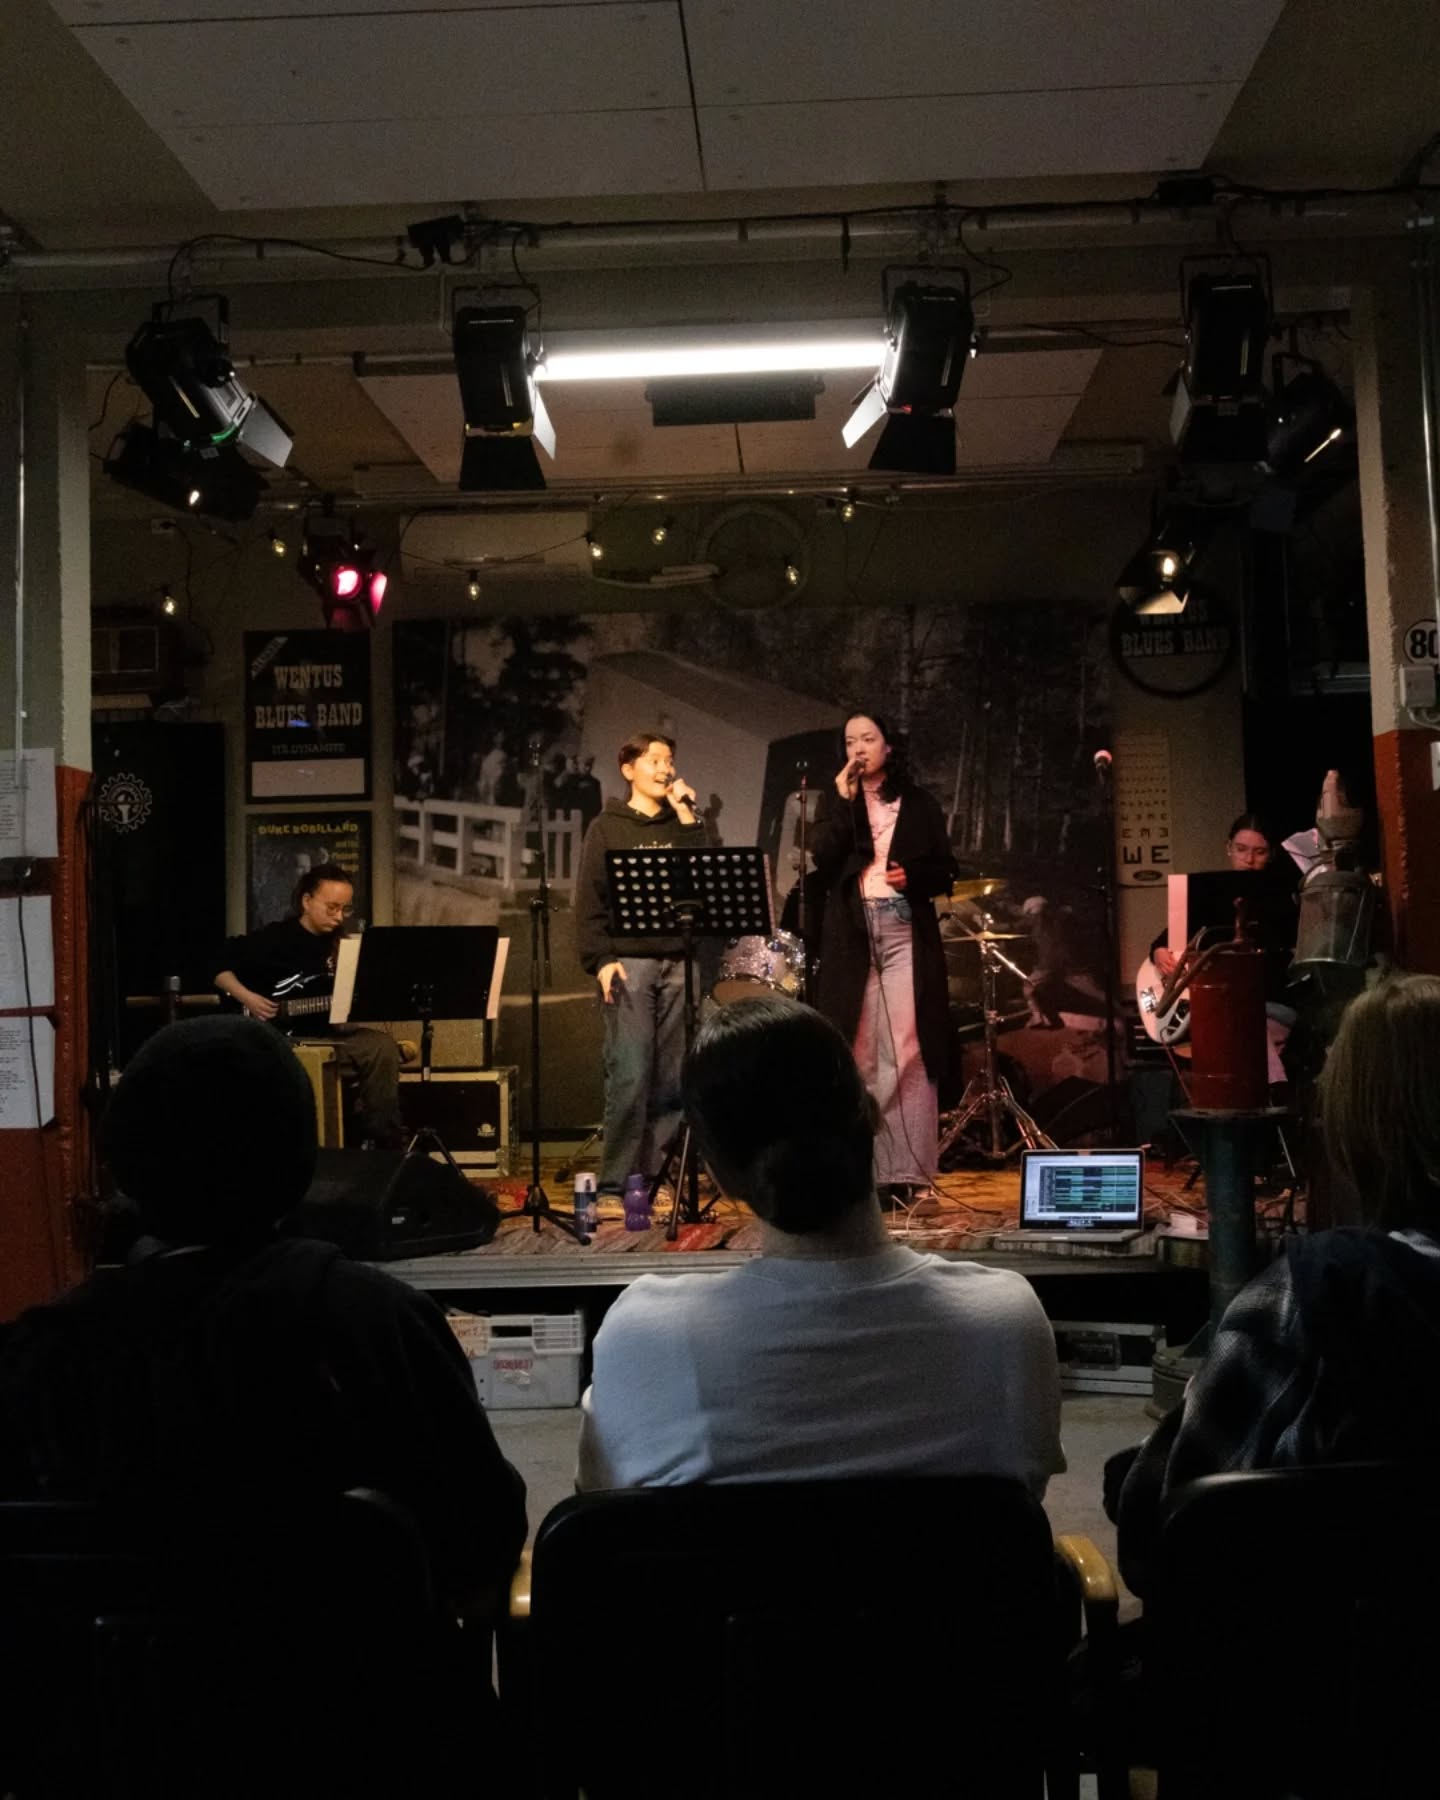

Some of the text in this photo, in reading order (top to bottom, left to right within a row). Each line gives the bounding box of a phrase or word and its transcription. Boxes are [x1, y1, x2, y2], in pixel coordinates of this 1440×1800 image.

[1120, 631, 1176, 656] BLUES
[273, 664, 344, 689] WENTUS
[255, 702, 363, 729] BLUES BAND
[258, 824, 291, 835] DUKE
